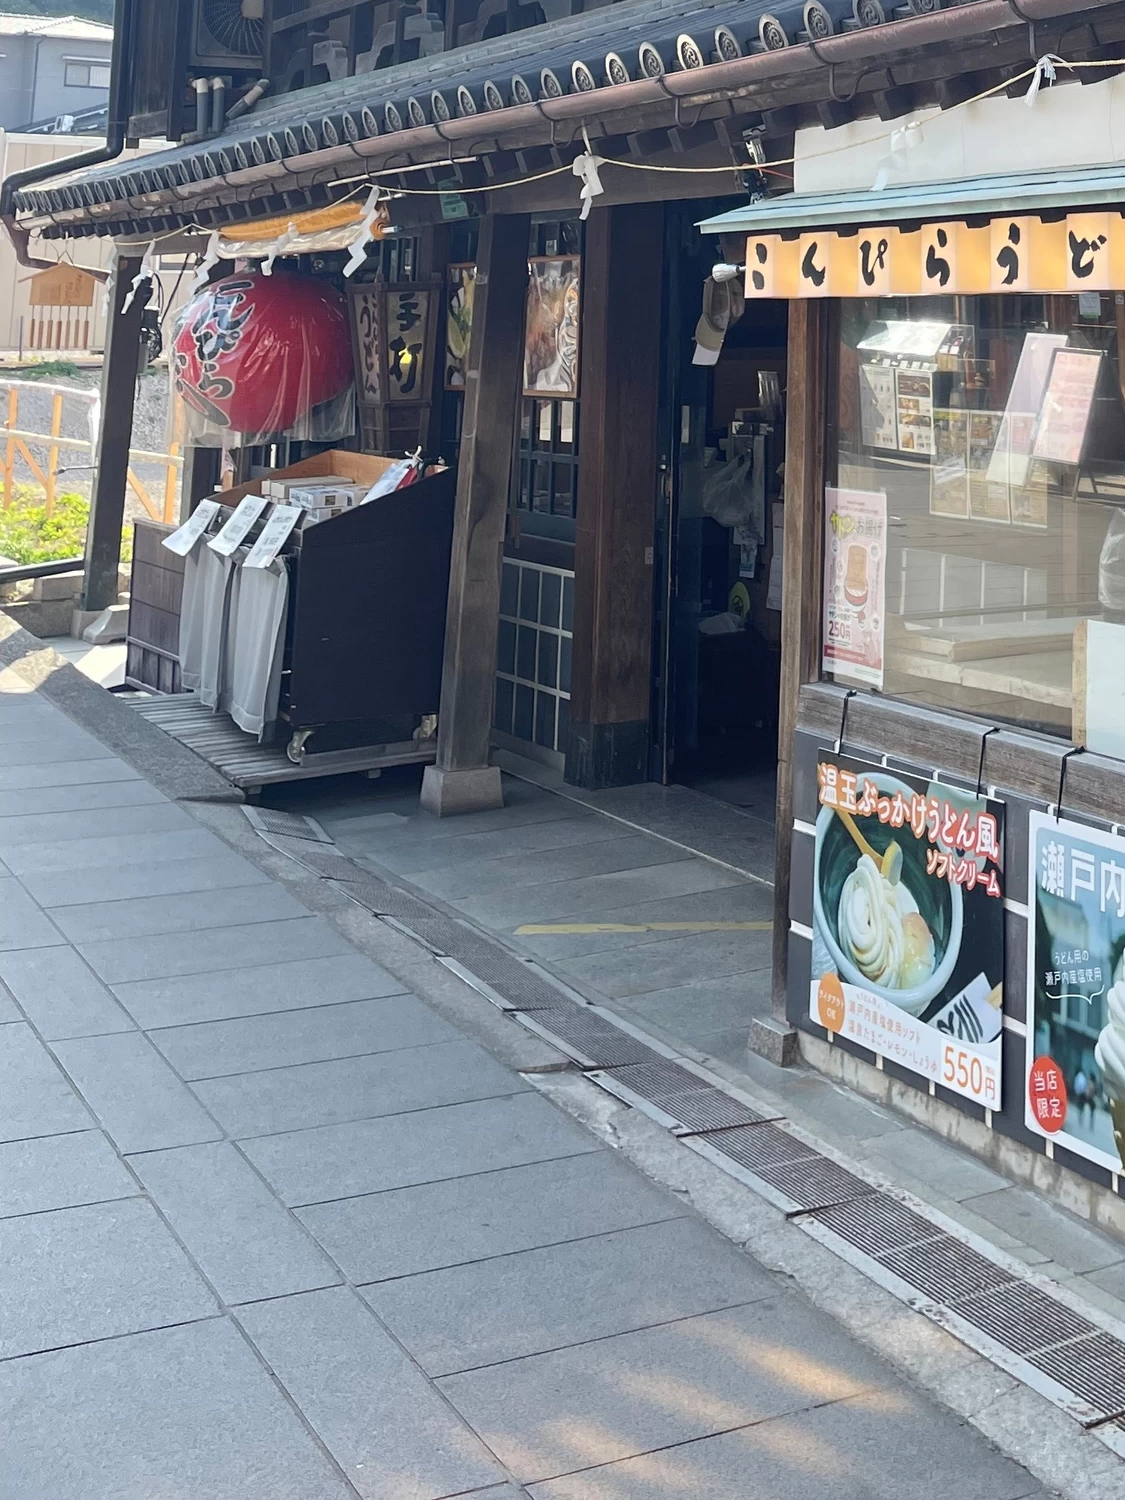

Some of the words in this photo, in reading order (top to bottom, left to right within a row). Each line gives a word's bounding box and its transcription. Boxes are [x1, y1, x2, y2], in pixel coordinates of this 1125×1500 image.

[819, 765, 998, 857] 温玉ぶっかけうどん風
[926, 851, 1000, 896] ソフトクリーム
[1054, 949, 1089, 966] うどん用の
[943, 1045, 995, 1101] 550円
[1033, 1068, 1058, 1095] 当店
[1036, 1093, 1062, 1120] 限定
